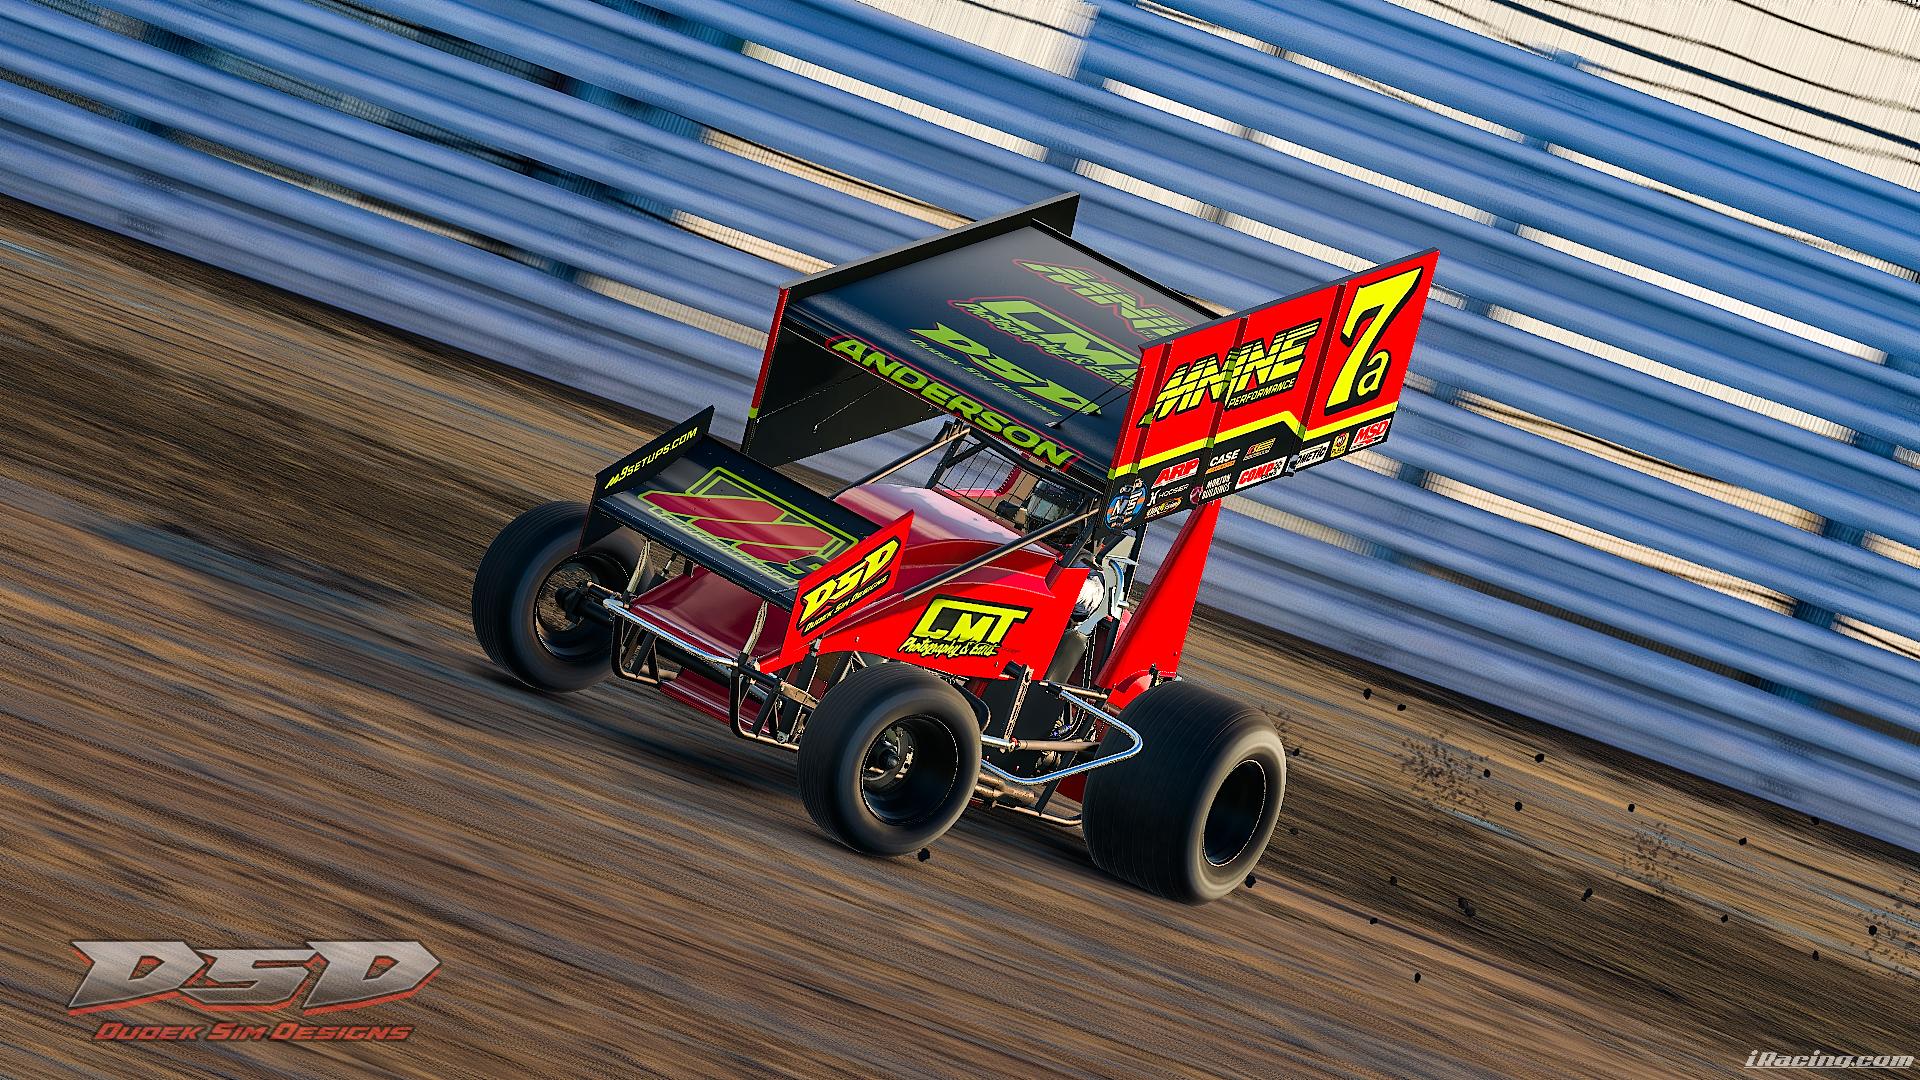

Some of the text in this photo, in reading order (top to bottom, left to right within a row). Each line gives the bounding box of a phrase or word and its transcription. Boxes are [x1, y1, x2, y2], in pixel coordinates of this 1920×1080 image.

[910, 321, 1102, 415] DSD
[830, 338, 1076, 468] ANDERSON
[1227, 377, 1297, 409] PERFORMANCE
[1353, 420, 1390, 446] MSD
[1209, 448, 1241, 468] CASE
[1152, 459, 1199, 488] ARP
[1238, 461, 1276, 486] COMP
[799, 539, 900, 624] DSD
[911, 598, 1029, 644] CMT
[898, 637, 960, 658] Photography
